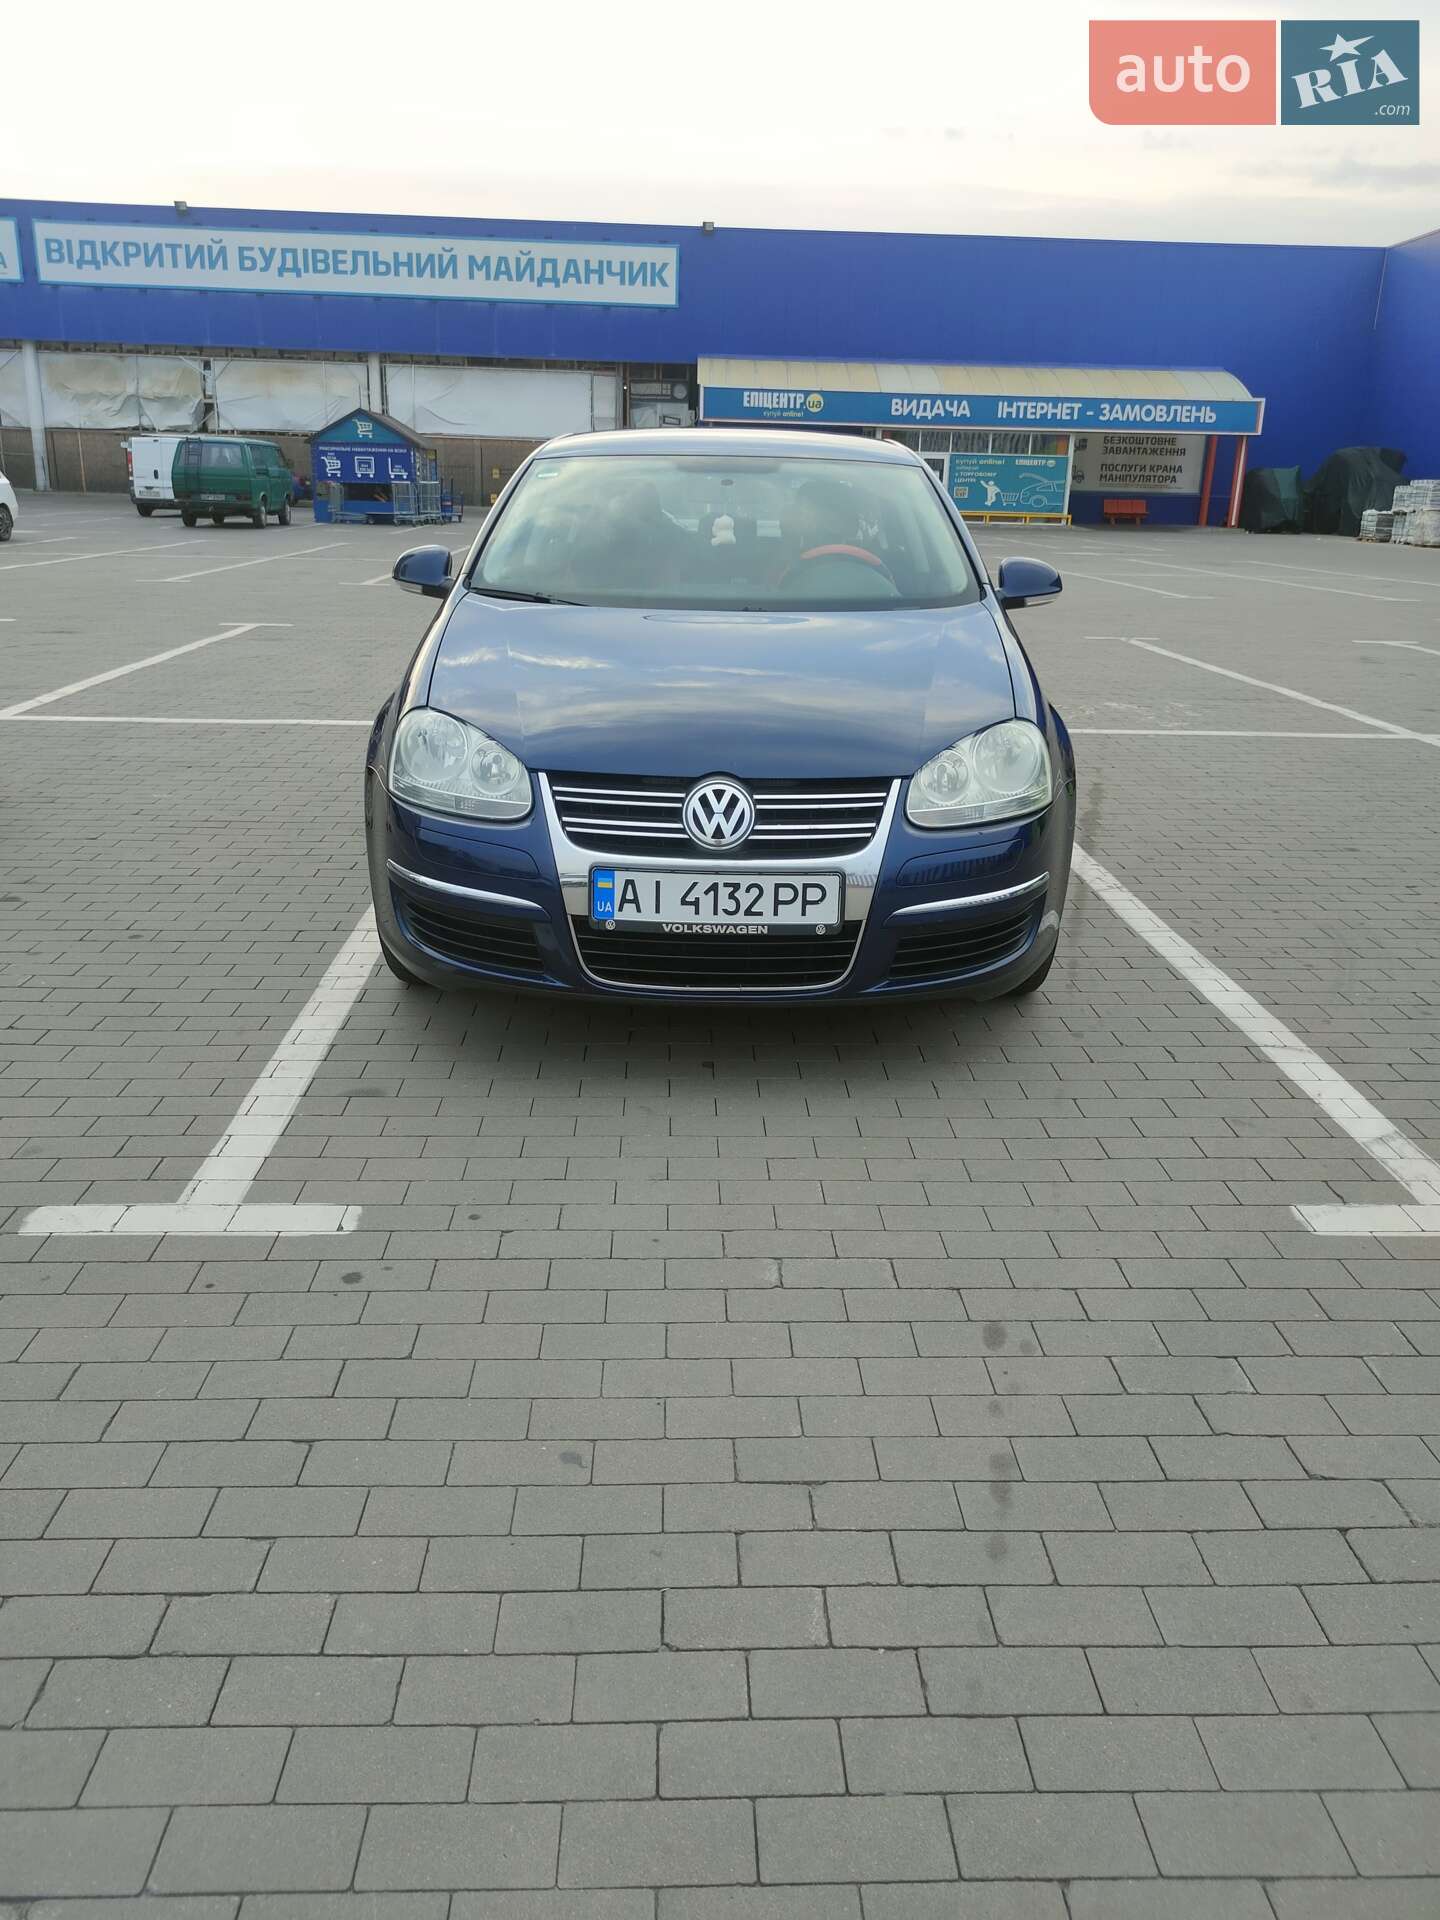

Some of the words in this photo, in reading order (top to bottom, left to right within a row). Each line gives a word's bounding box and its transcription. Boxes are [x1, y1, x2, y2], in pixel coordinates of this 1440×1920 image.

[44, 237, 228, 271] ВІДКРИТИЙ
[237, 246, 458, 279] БУДІВЕЛЬНИЙ
[467, 250, 669, 288] МАЙДАНЧИК
[891, 398, 971, 419] ВИДАЧА
[997, 401, 1081, 420] ІНТЕРНЕТ
[1098, 403, 1217, 423] ЗАМОВЛЕНЬ
[1103, 435, 1177, 447] БЕЗКОШТОВНЕ
[1103, 446, 1186, 457] ЗАВАНТАЖЕННЯ
[1100, 463, 1147, 473] ПОСЛУГИ
[1149, 464, 1183, 474] КРАНА
[1099, 473, 1177, 484] МАНІПУЛЯТОРА
[597, 900, 613, 912] UA
[662, 923, 769, 935] VOLKSWAGEN
